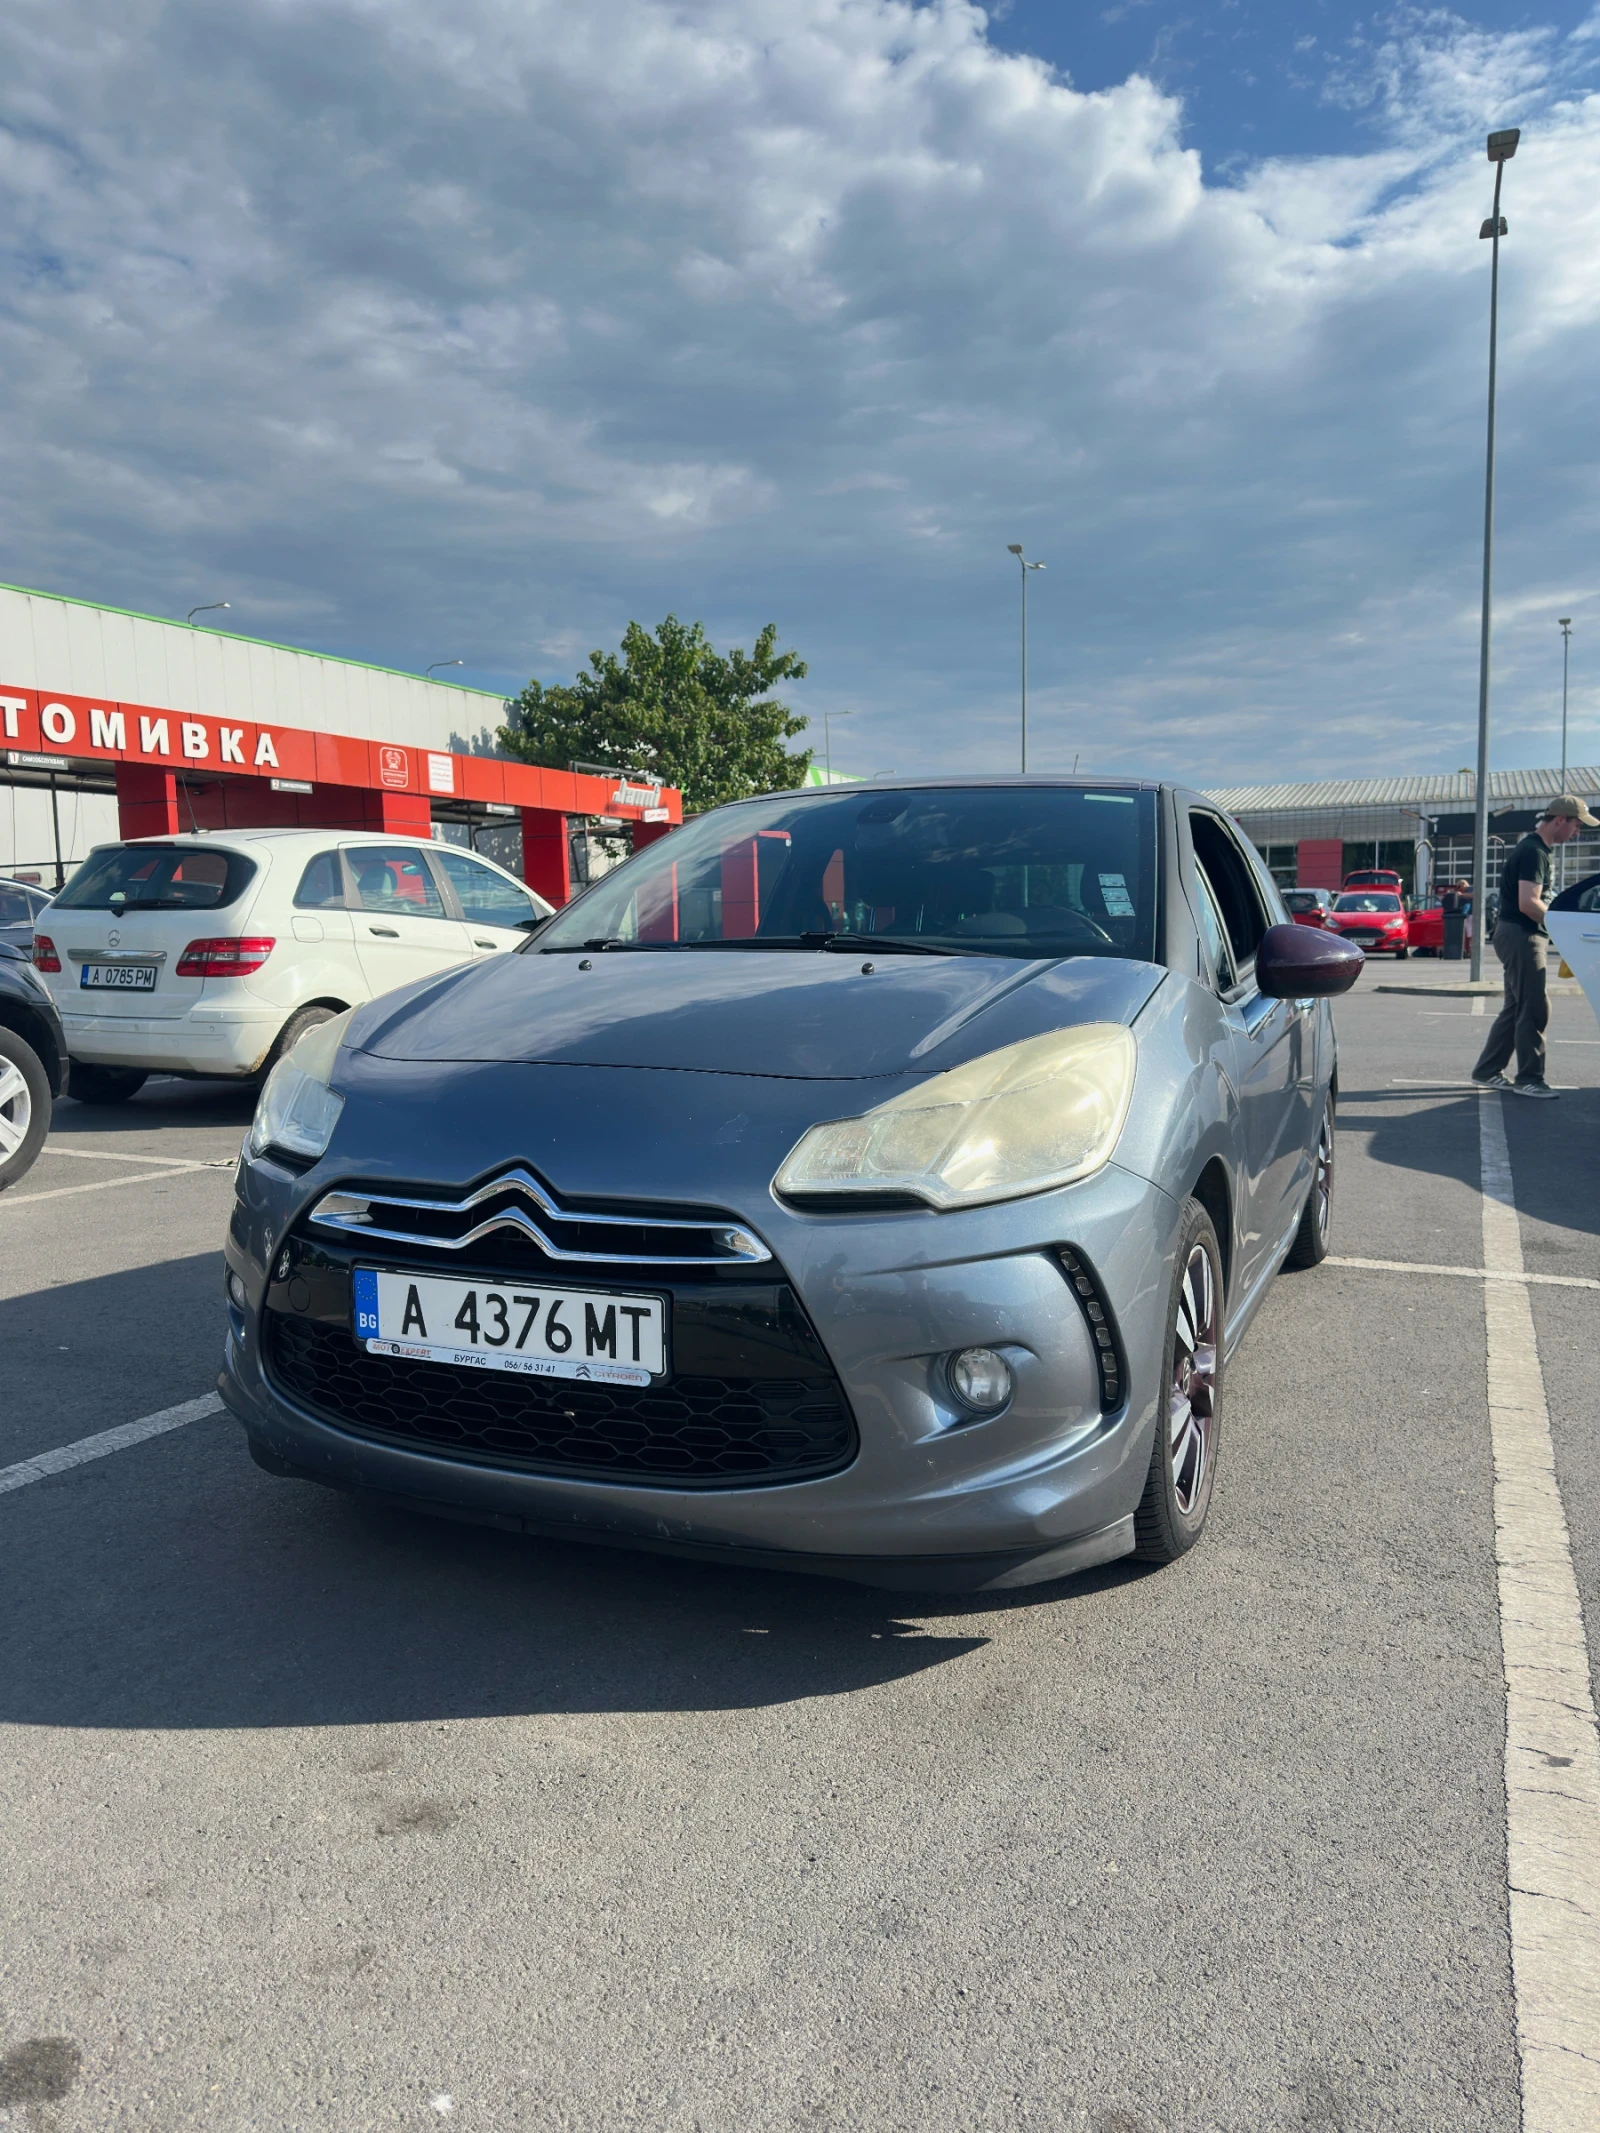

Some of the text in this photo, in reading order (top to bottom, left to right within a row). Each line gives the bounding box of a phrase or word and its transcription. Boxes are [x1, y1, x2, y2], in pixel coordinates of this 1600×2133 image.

[0, 695, 279, 768] ТОМИВКА
[92, 968, 153, 985] A 0785 PM
[359, 1312, 377, 1329] BG
[401, 1284, 652, 1362] A 4376 MT
[453, 1354, 556, 1374] БУРГАС 056/ 56 31 41
